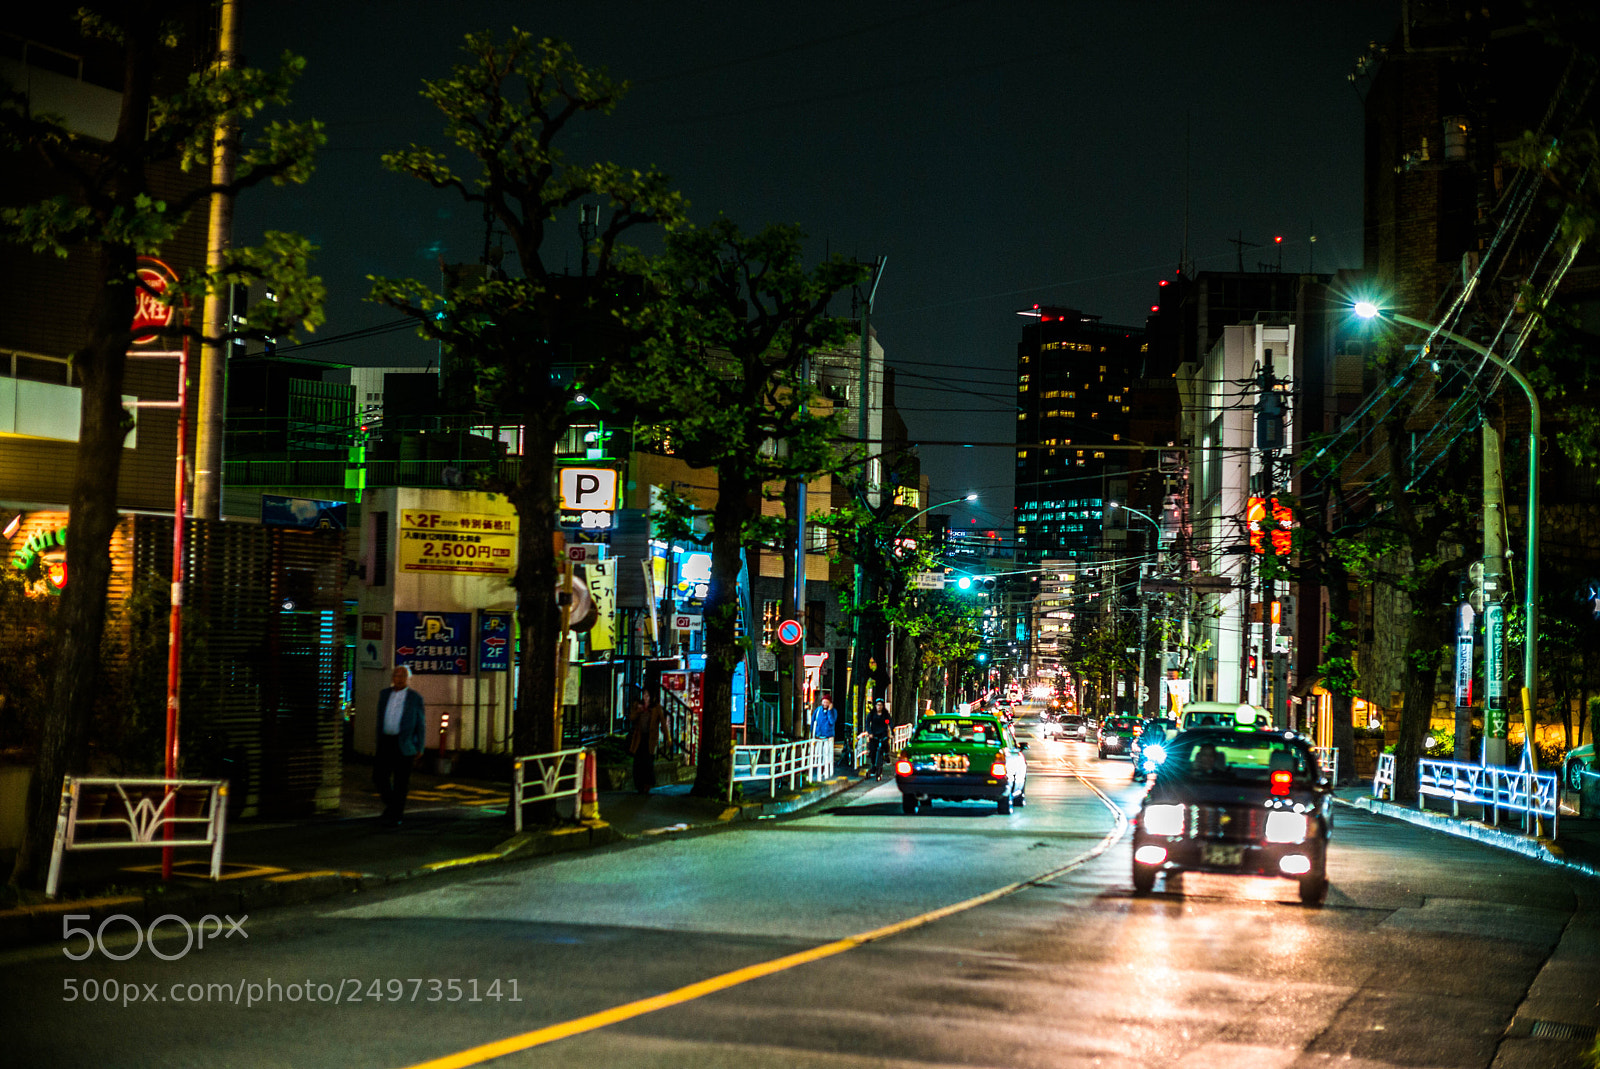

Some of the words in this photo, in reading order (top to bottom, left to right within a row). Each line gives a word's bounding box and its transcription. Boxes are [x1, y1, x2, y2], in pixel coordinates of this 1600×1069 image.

[134, 293, 166, 320] 火栓
[576, 474, 600, 504] P
[423, 542, 491, 559] 2,500円
[487, 647, 504, 658] 2F
